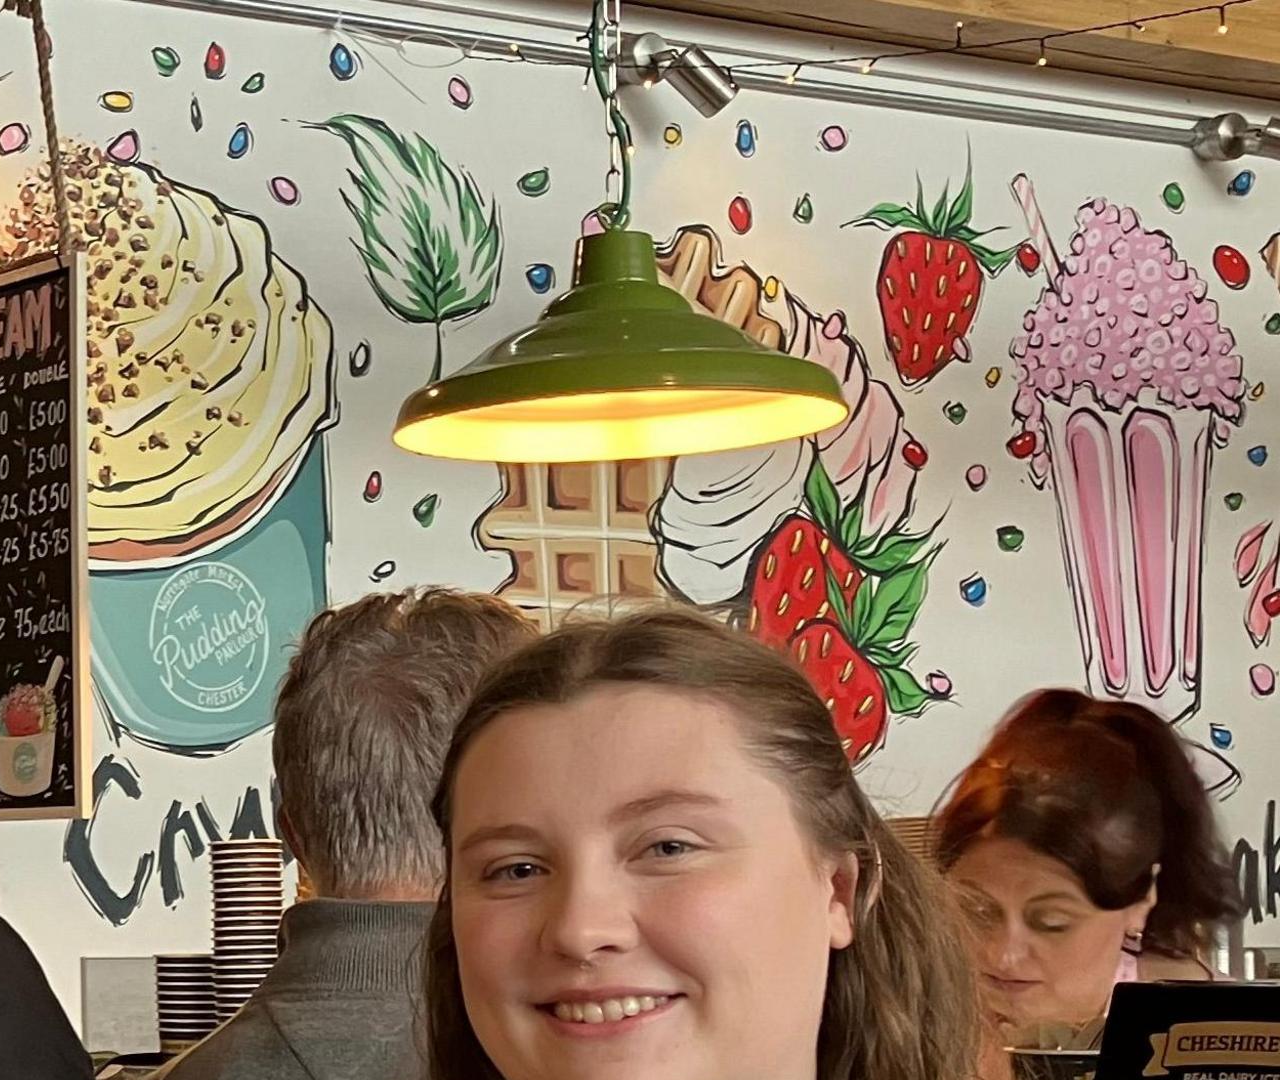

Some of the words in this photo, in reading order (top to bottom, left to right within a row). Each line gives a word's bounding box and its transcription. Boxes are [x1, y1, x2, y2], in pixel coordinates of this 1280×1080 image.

[22, 360, 69, 391] DOUBLE
[39, 603, 71, 635] each
[174, 604, 203, 631] THE
[153, 597, 266, 690] Pudding
[214, 627, 259, 667] PARLOUR
[197, 681, 248, 706] CHESTER
[1177, 1034, 1280, 1053] CHESHIRE
